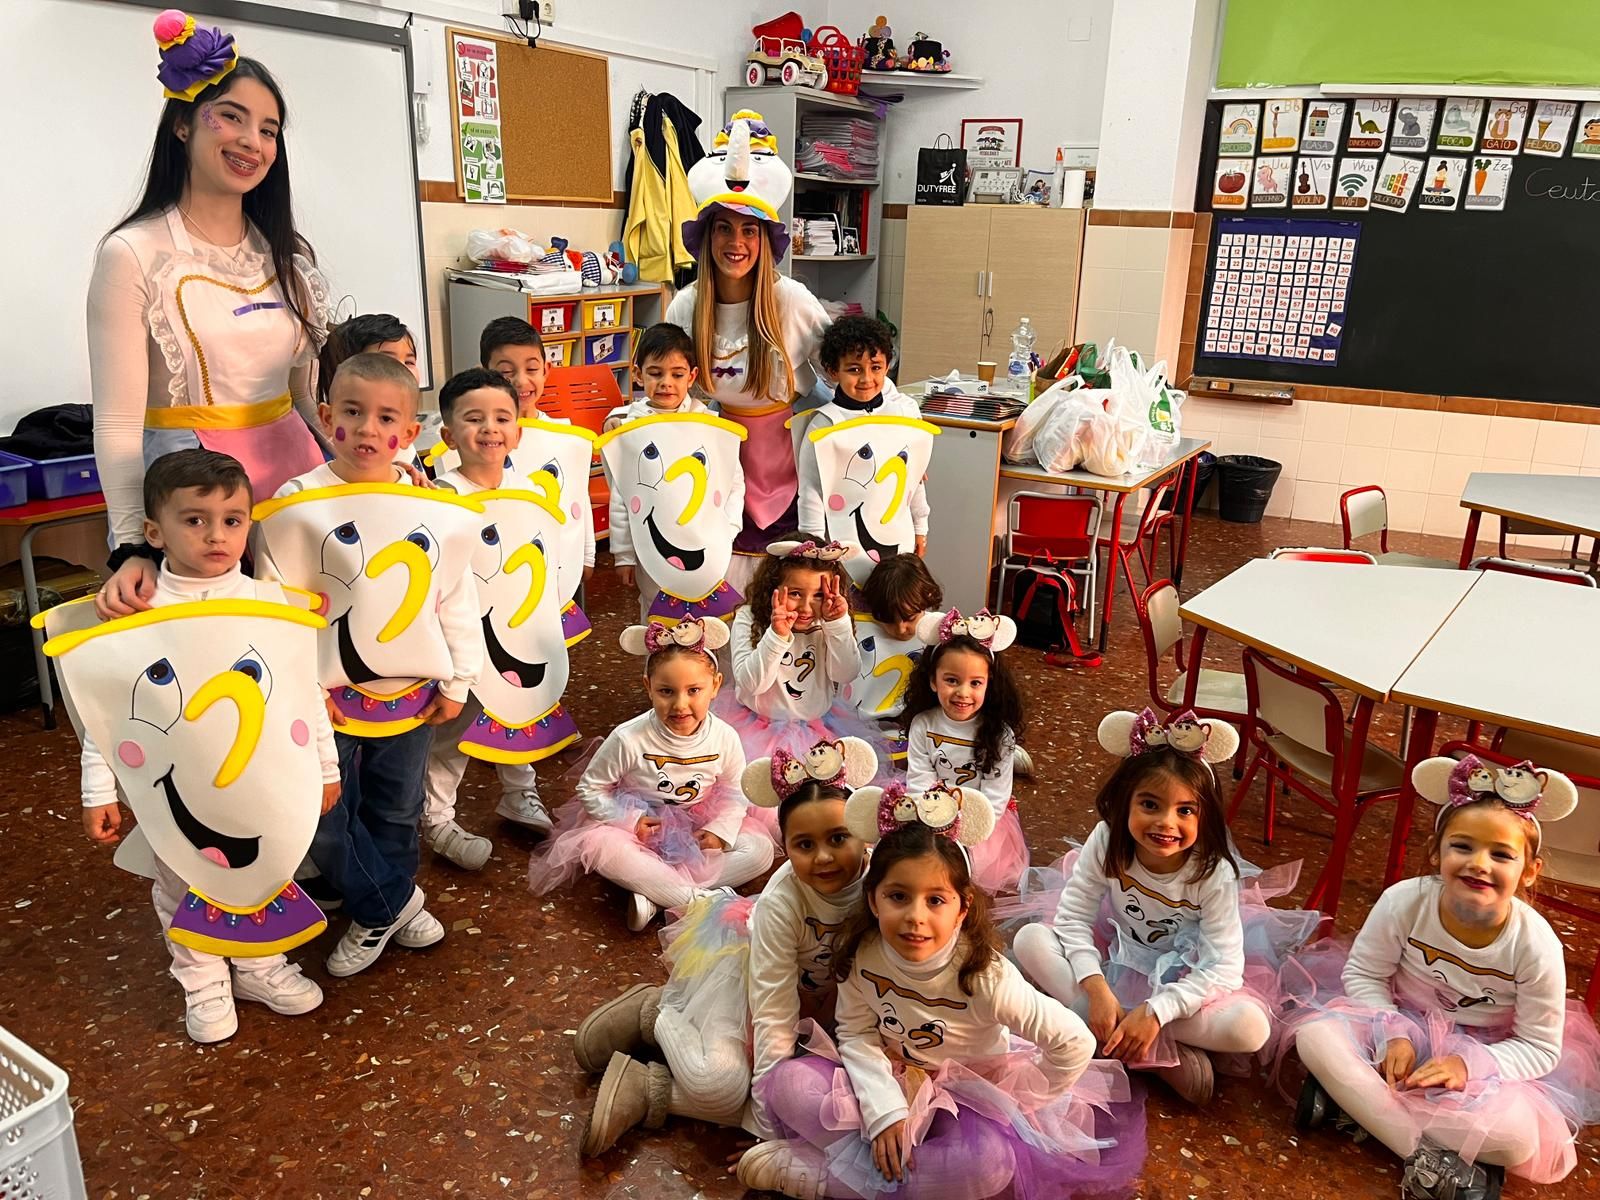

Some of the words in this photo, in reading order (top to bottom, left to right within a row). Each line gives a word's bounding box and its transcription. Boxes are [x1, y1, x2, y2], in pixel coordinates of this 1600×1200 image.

[1241, 105, 1257, 117] Aa
[1328, 103, 1342, 116] Cc
[1372, 100, 1391, 113] Dd
[1510, 102, 1527, 118] Gg
[1306, 141, 1328, 150] CASA
[1392, 138, 1424, 146] ELEFANTE
[1486, 140, 1511, 149] GATO
[1527, 141, 1559, 150] HELADO
[1272, 158, 1289, 170] Uu
[1314, 160, 1331, 170] Vv
[1353, 160, 1374, 172] Ww
[1400, 160, 1419, 174] Xx
[1452, 160, 1464, 177] Yy
[1493, 159, 1509, 171] Zz
[918, 184, 956, 194] DUTYFREE
[1252, 194, 1283, 203] UNICORNIO
[1341, 197, 1359, 206] WIFI
